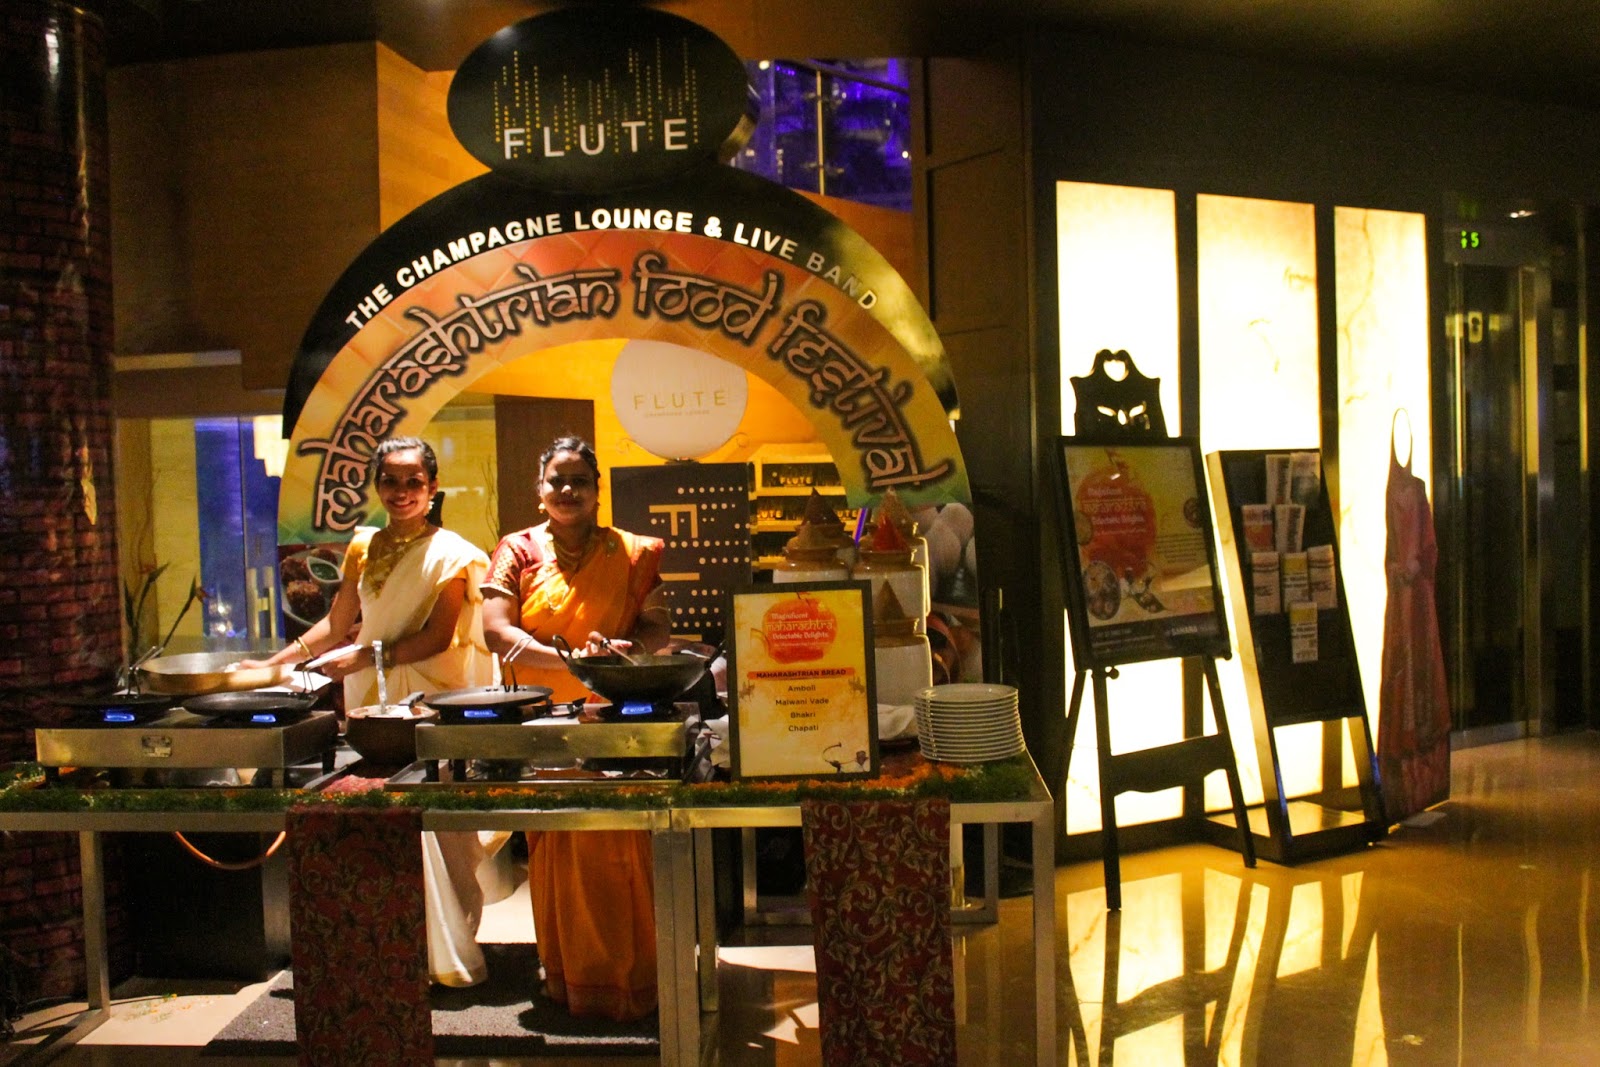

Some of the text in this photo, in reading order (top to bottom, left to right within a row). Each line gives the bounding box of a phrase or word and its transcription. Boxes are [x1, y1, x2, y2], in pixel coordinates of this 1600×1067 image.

[503, 118, 689, 160] FLUTE
[345, 208, 878, 330] THE CHAMPAGNE LOUNGE & LIVE BAND
[633, 389, 727, 411] FLUTE
[779, 476, 812, 485] FLUTE
[757, 509, 783, 519] UTE
[837, 509, 858, 518] UTE
[756, 670, 820, 678] MAHARASHTRIAN
